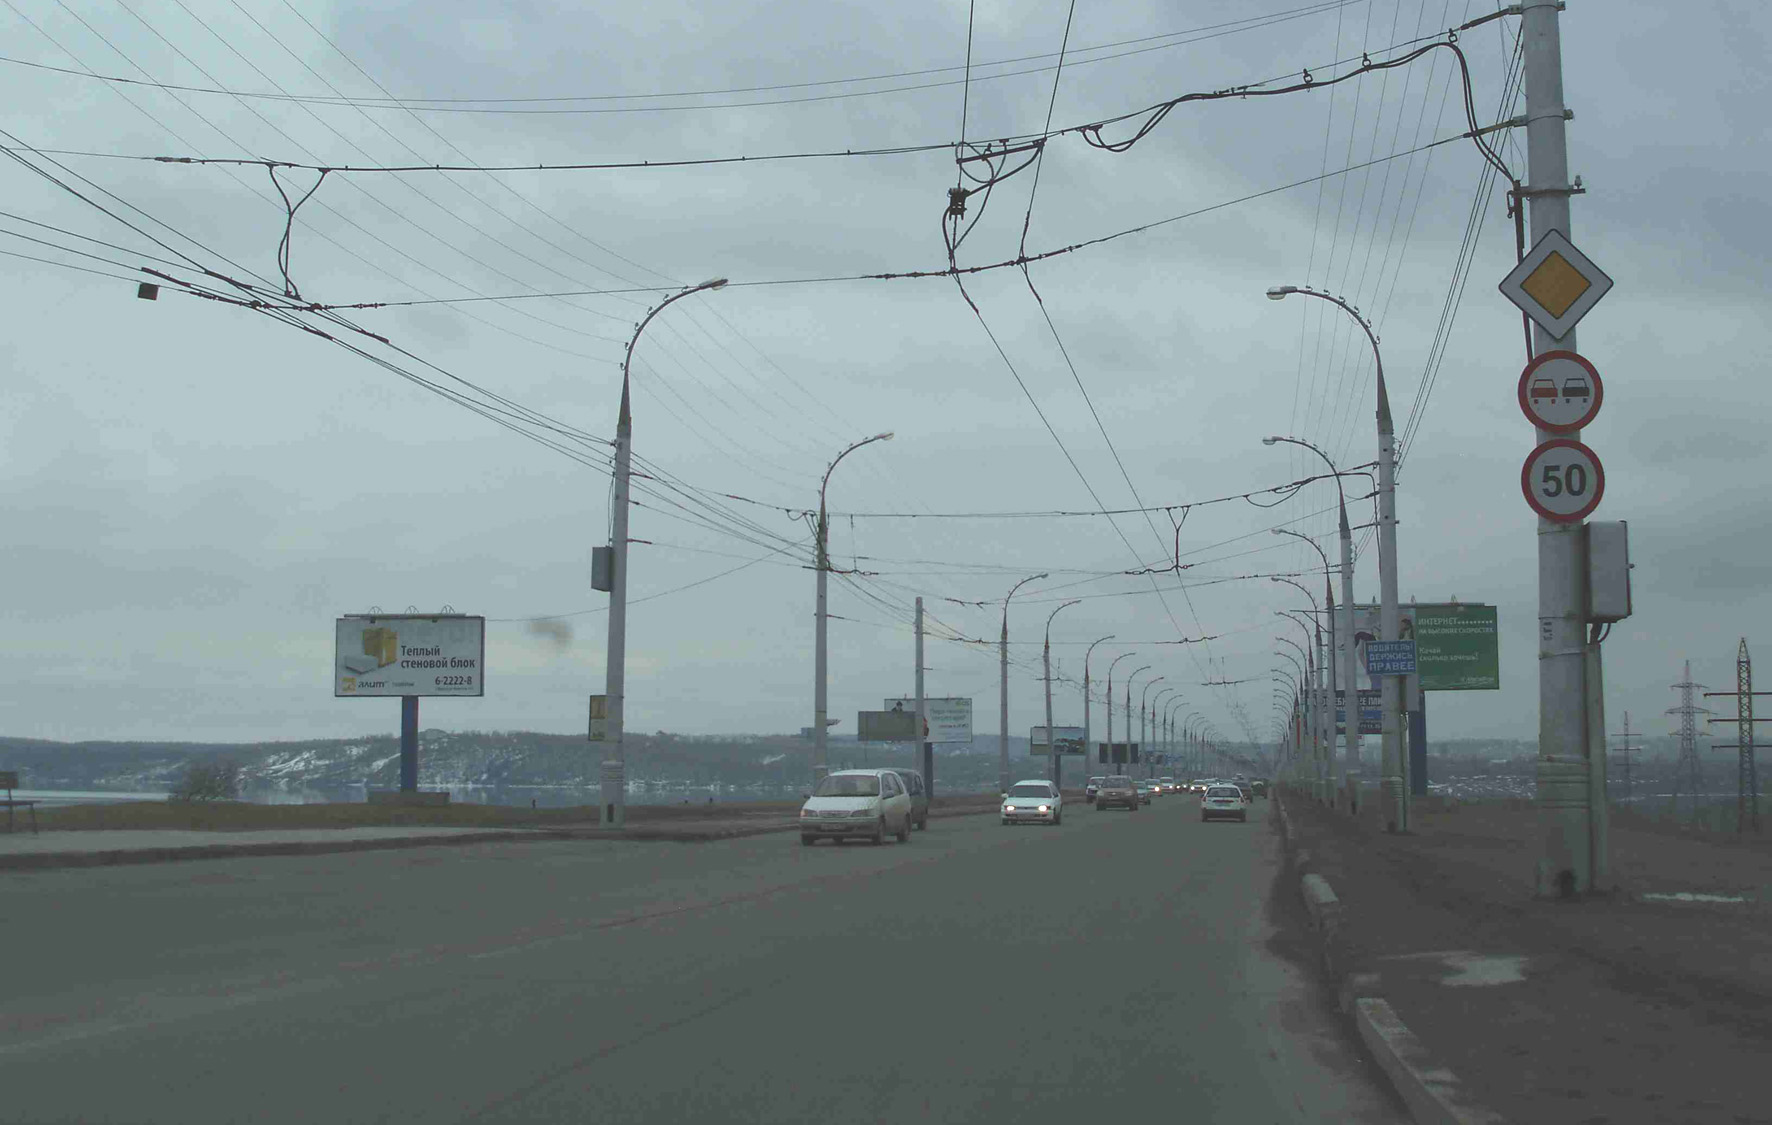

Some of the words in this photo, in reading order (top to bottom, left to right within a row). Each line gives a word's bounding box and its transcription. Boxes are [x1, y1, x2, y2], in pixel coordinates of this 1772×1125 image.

[1541, 463, 1587, 498] 50
[401, 645, 441, 656] Теплый
[401, 657, 448, 668] стеновой
[450, 656, 476, 668] блок
[1369, 652, 1413, 661] ДЕРЖИСЬ
[1369, 661, 1415, 671] ПРАВЕЕ
[435, 675, 473, 686] 6-2222-8
